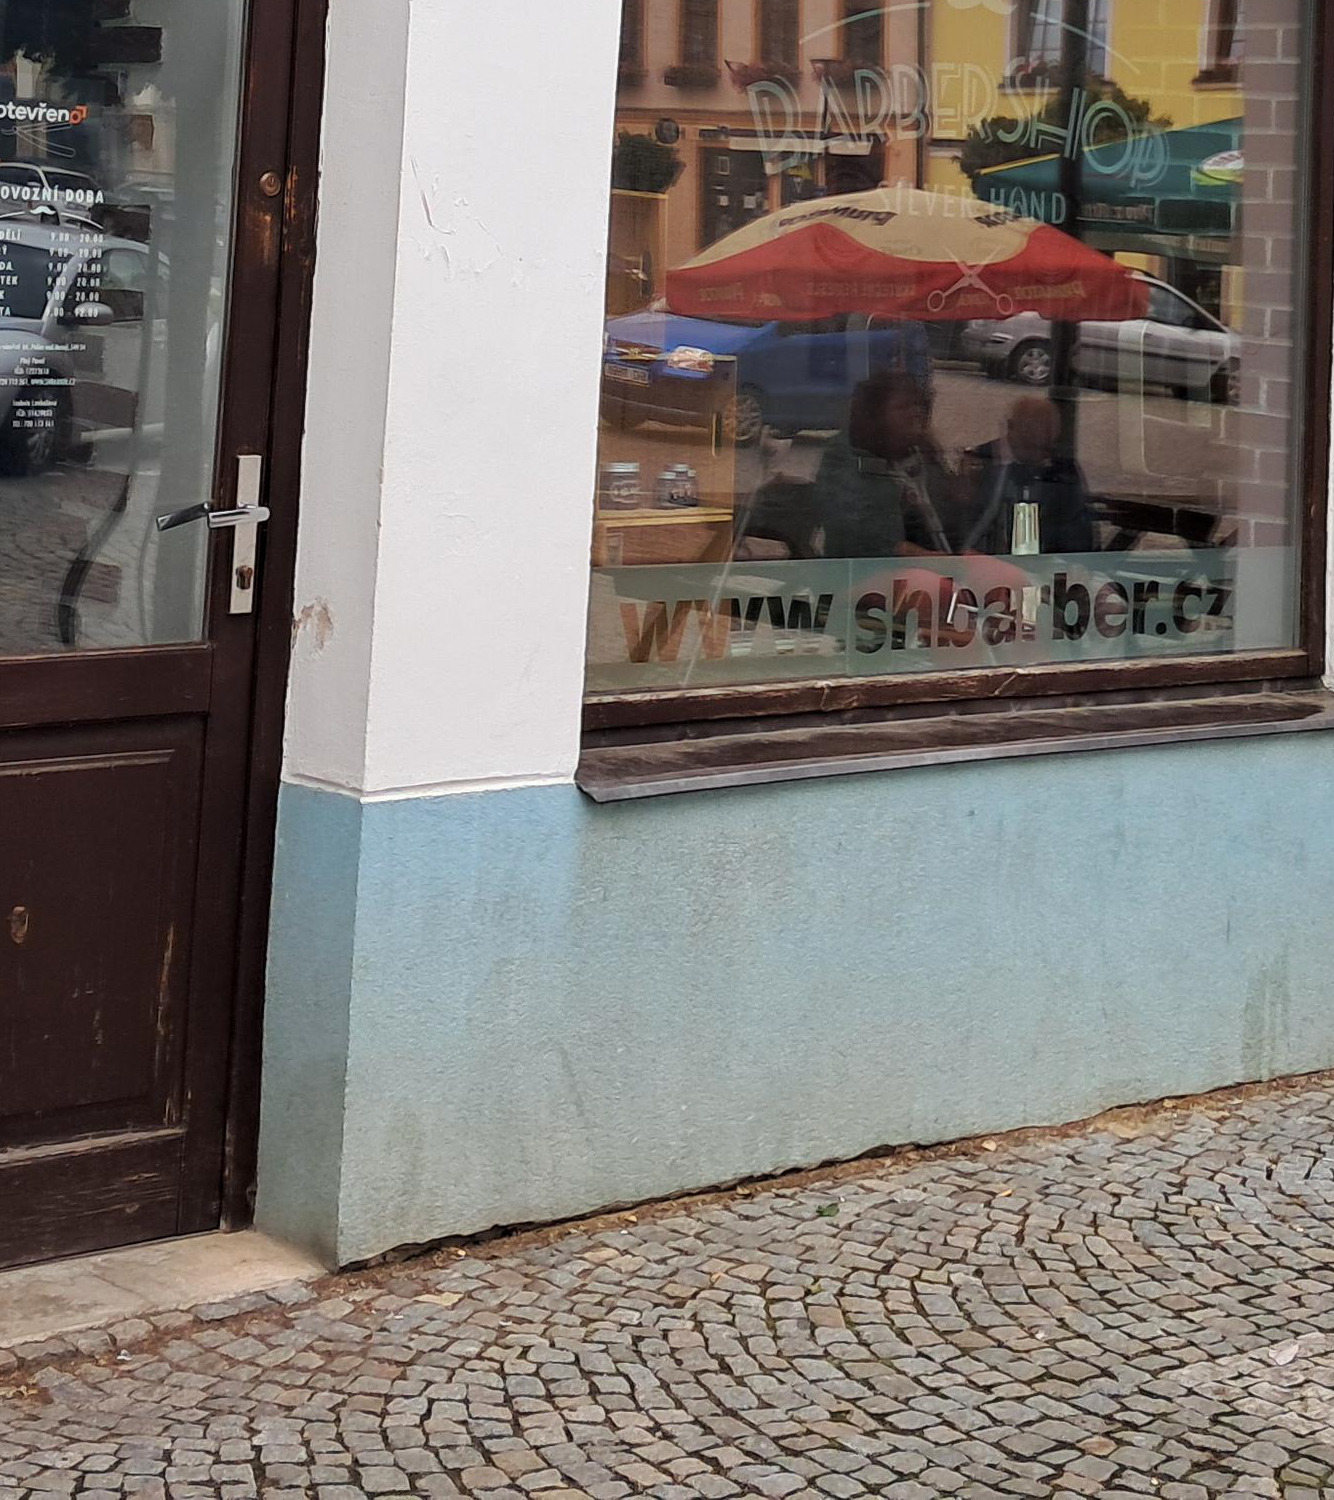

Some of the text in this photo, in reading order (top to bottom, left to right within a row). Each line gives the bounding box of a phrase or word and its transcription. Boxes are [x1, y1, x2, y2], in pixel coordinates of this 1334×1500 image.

[64, 188, 105, 205] DOBA
[877, 177, 976, 219] SILVER
[989, 186, 1067, 225] HAND
